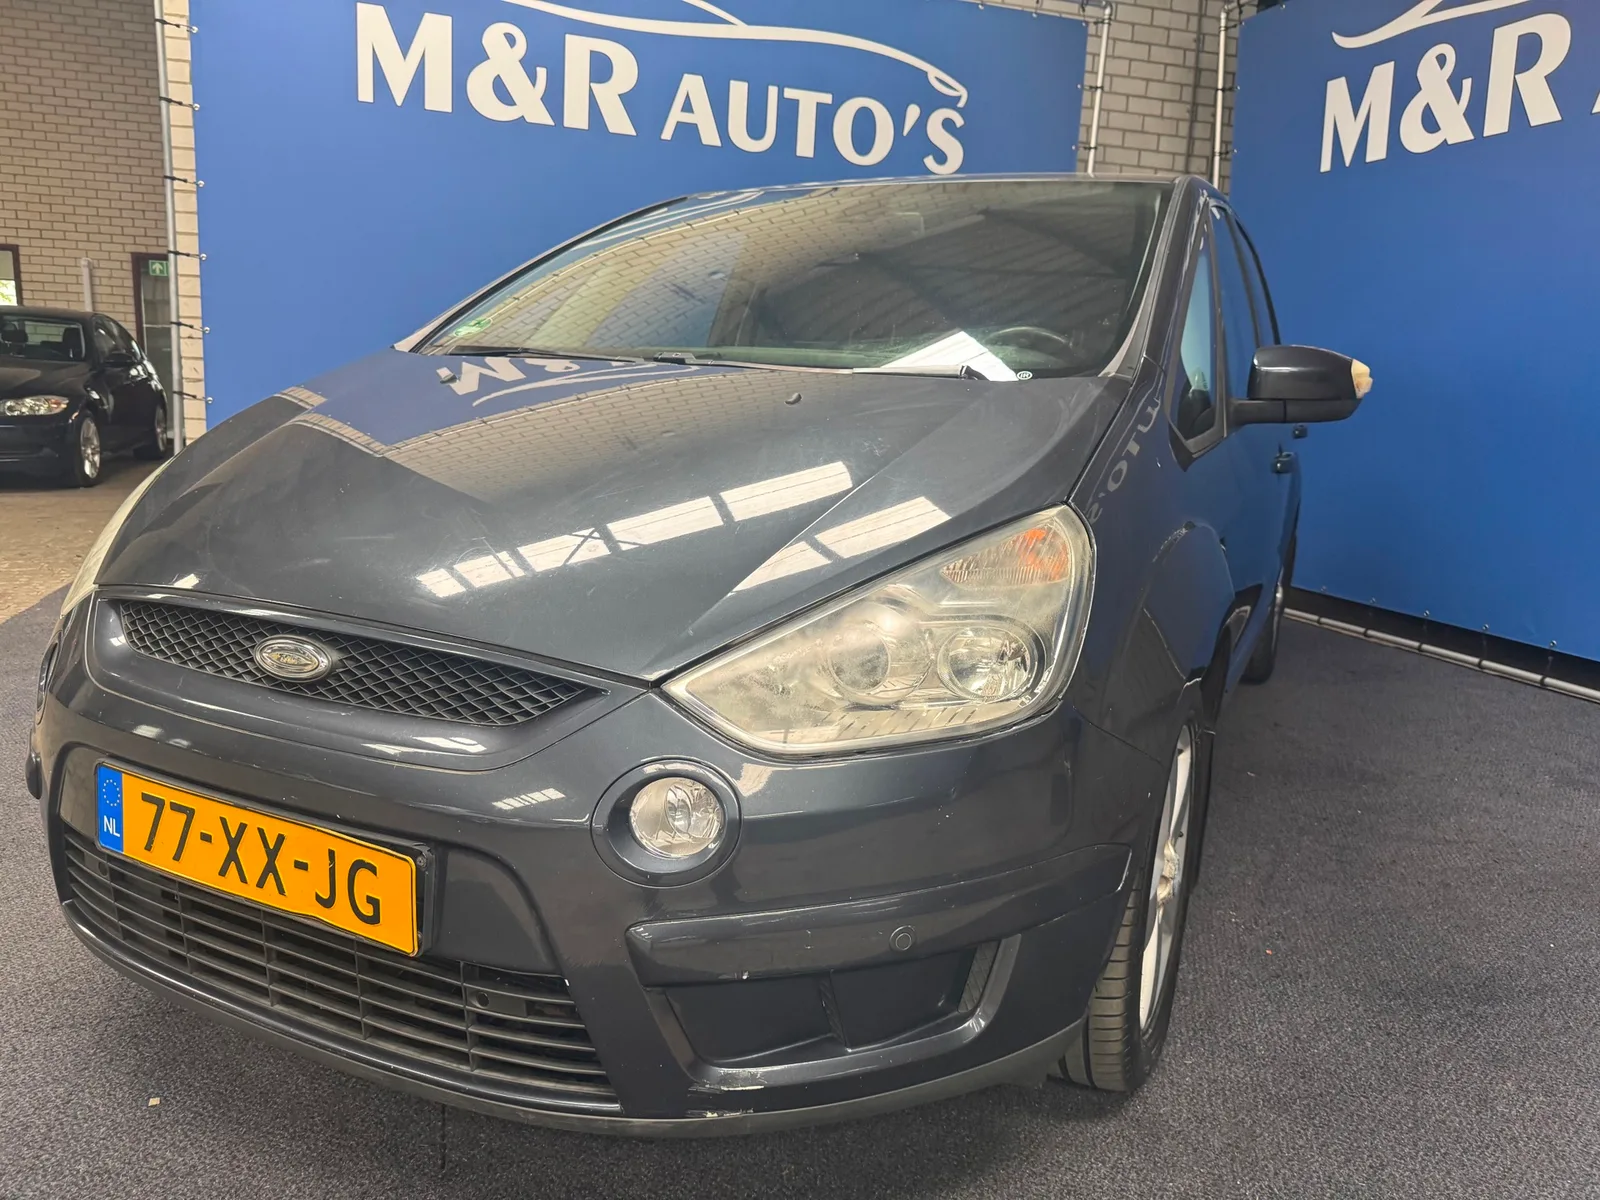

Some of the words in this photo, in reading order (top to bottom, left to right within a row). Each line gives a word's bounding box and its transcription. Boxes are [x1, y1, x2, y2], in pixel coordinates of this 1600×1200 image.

[356, 2, 637, 136] M&R
[660, 73, 964, 175] AUTO'S
[1320, 13, 1571, 173] M&R
[103, 815, 120, 838] NL
[141, 792, 381, 925] 77-XX-JG
